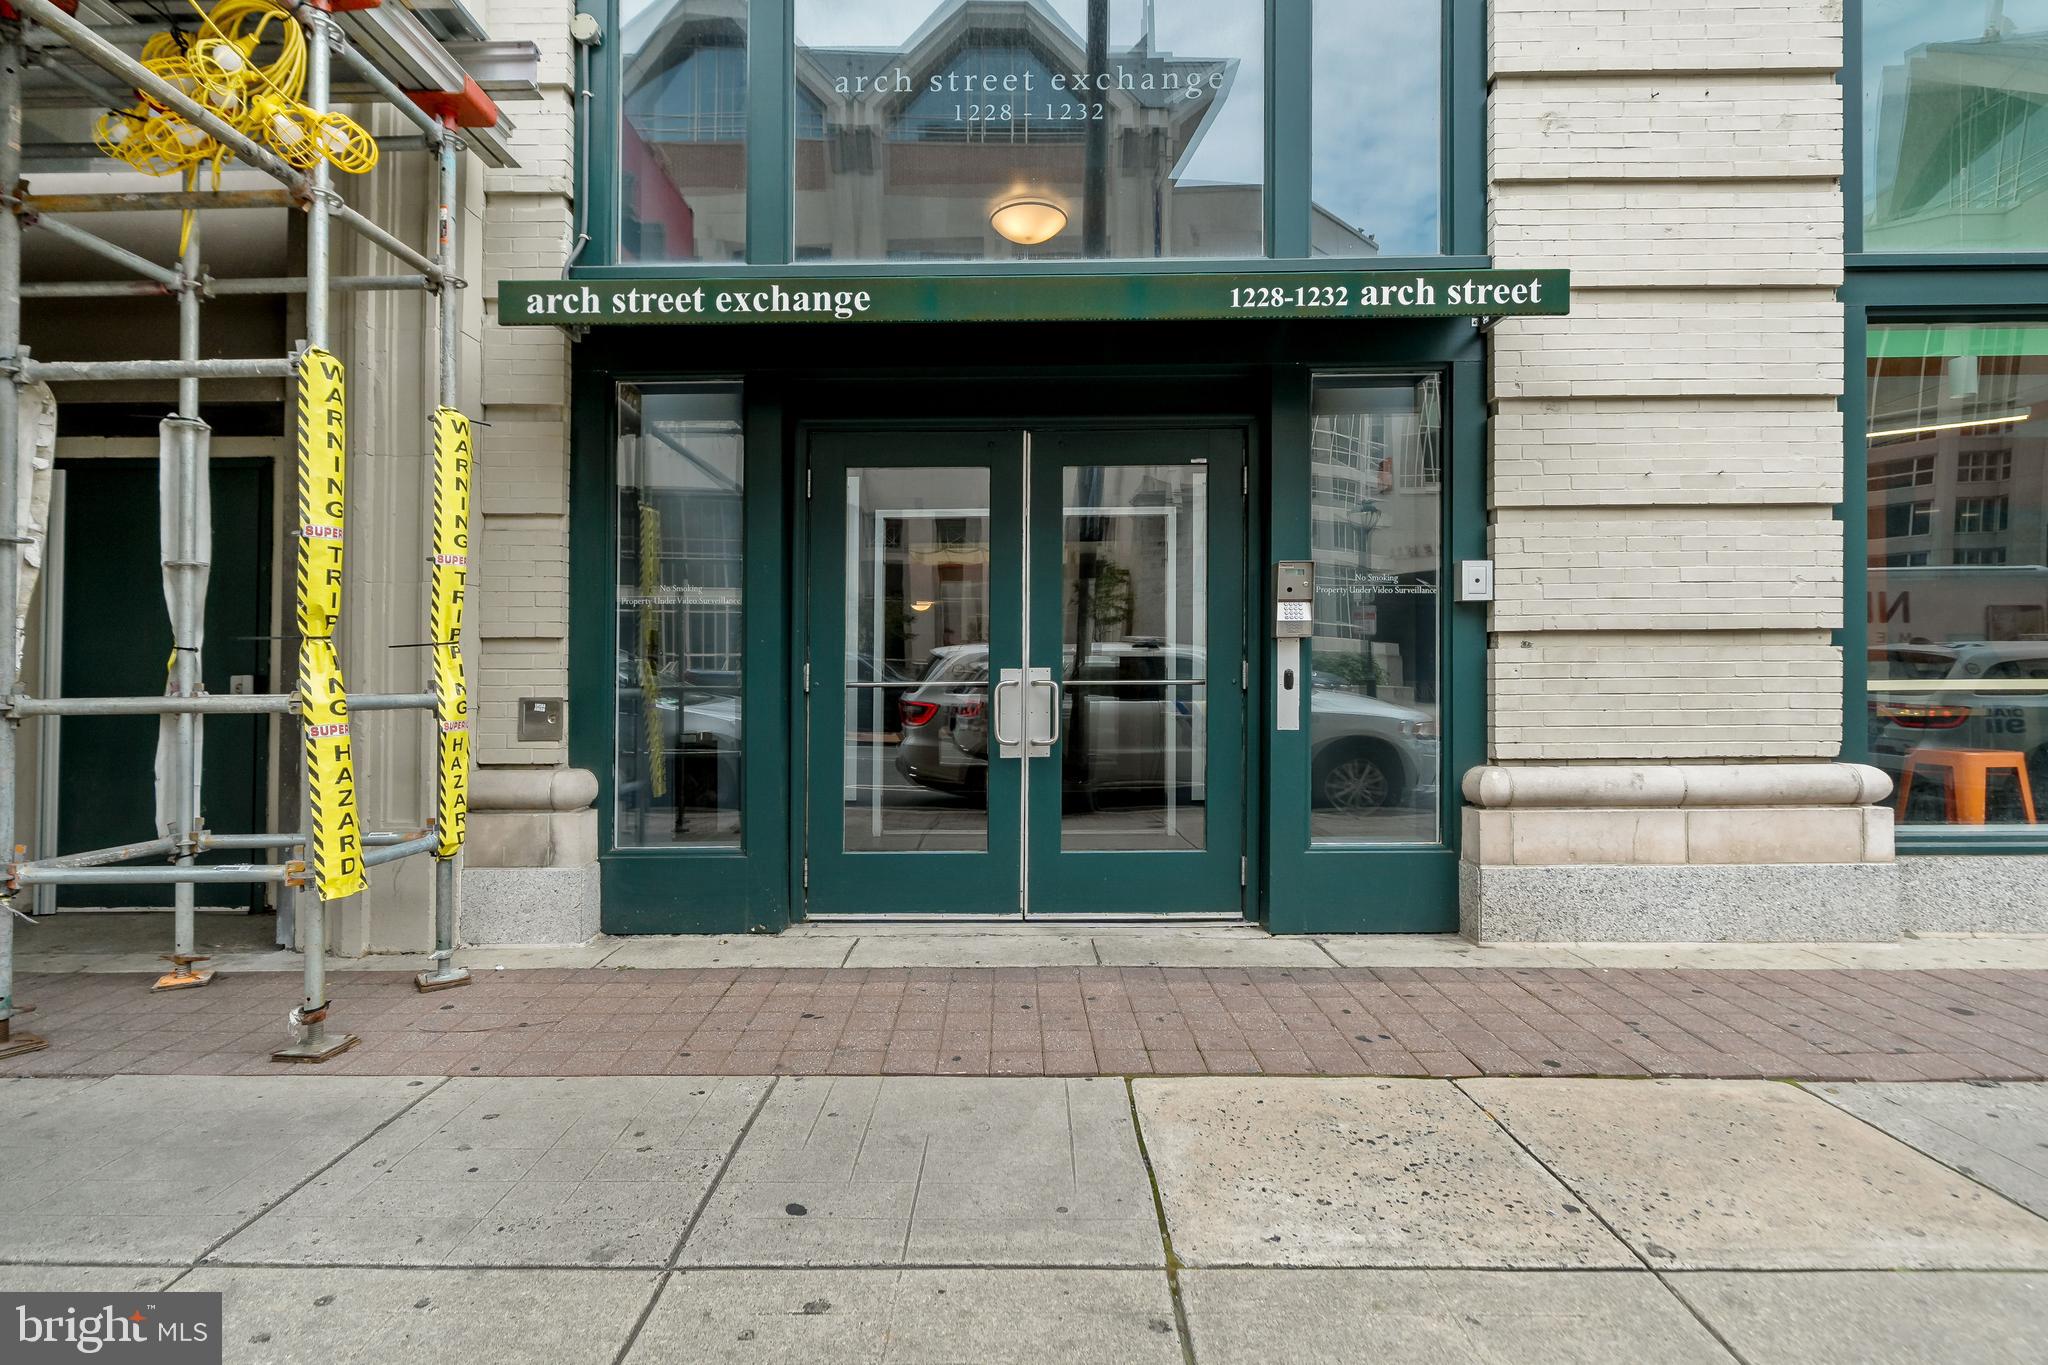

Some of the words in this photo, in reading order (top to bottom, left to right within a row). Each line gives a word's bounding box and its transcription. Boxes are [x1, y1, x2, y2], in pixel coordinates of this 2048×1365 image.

[834, 65, 913, 94] arch
[930, 69, 1035, 92] street
[1051, 65, 1225, 99] exchange
[954, 103, 1013, 122] 1228
[1045, 102, 1104, 121] 1232
[526, 286, 602, 314] arch
[612, 287, 705, 314] street
[715, 284, 871, 320] exchange
[1230, 286, 1349, 308] 1228-1232
[1360, 277, 1436, 306] arch
[1447, 277, 1542, 305] street
[319, 360, 344, 519] WARNING
[450, 418, 469, 549] WARNING
[659, 584, 671, 592] No
[672, 584, 703, 595] Smoking
[1315, 585, 1348, 597] Property
[1349, 585, 1373, 594] Under
[1373, 585, 1394, 594] Video
[1394, 585, 1438, 595] Surveillance
[1354, 573, 1367, 582] No
[1367, 573, 1399, 585] Smoking
[621, 597, 652, 607] Property
[449, 737, 466, 845] HAZARD
[334, 744, 356, 876] HAZARD
